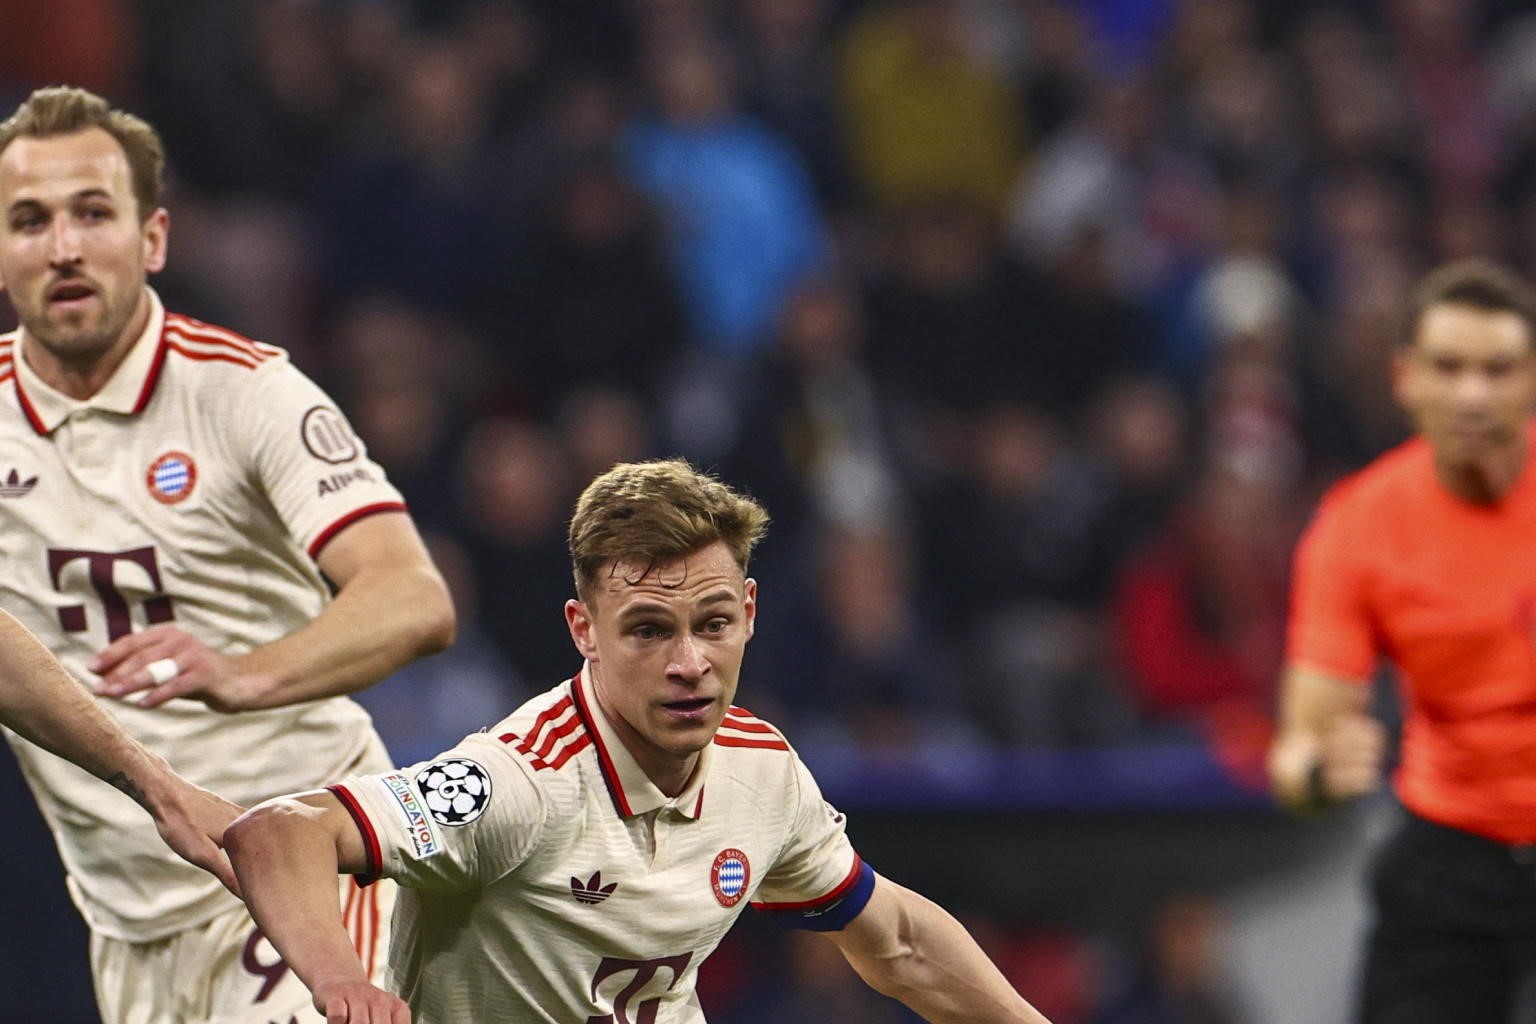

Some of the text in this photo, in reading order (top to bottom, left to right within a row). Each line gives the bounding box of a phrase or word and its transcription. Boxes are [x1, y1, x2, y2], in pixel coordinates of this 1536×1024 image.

[385, 775, 435, 855] FOUNDATION
[438, 779, 466, 800] 6
[242, 927, 289, 1005] 9
